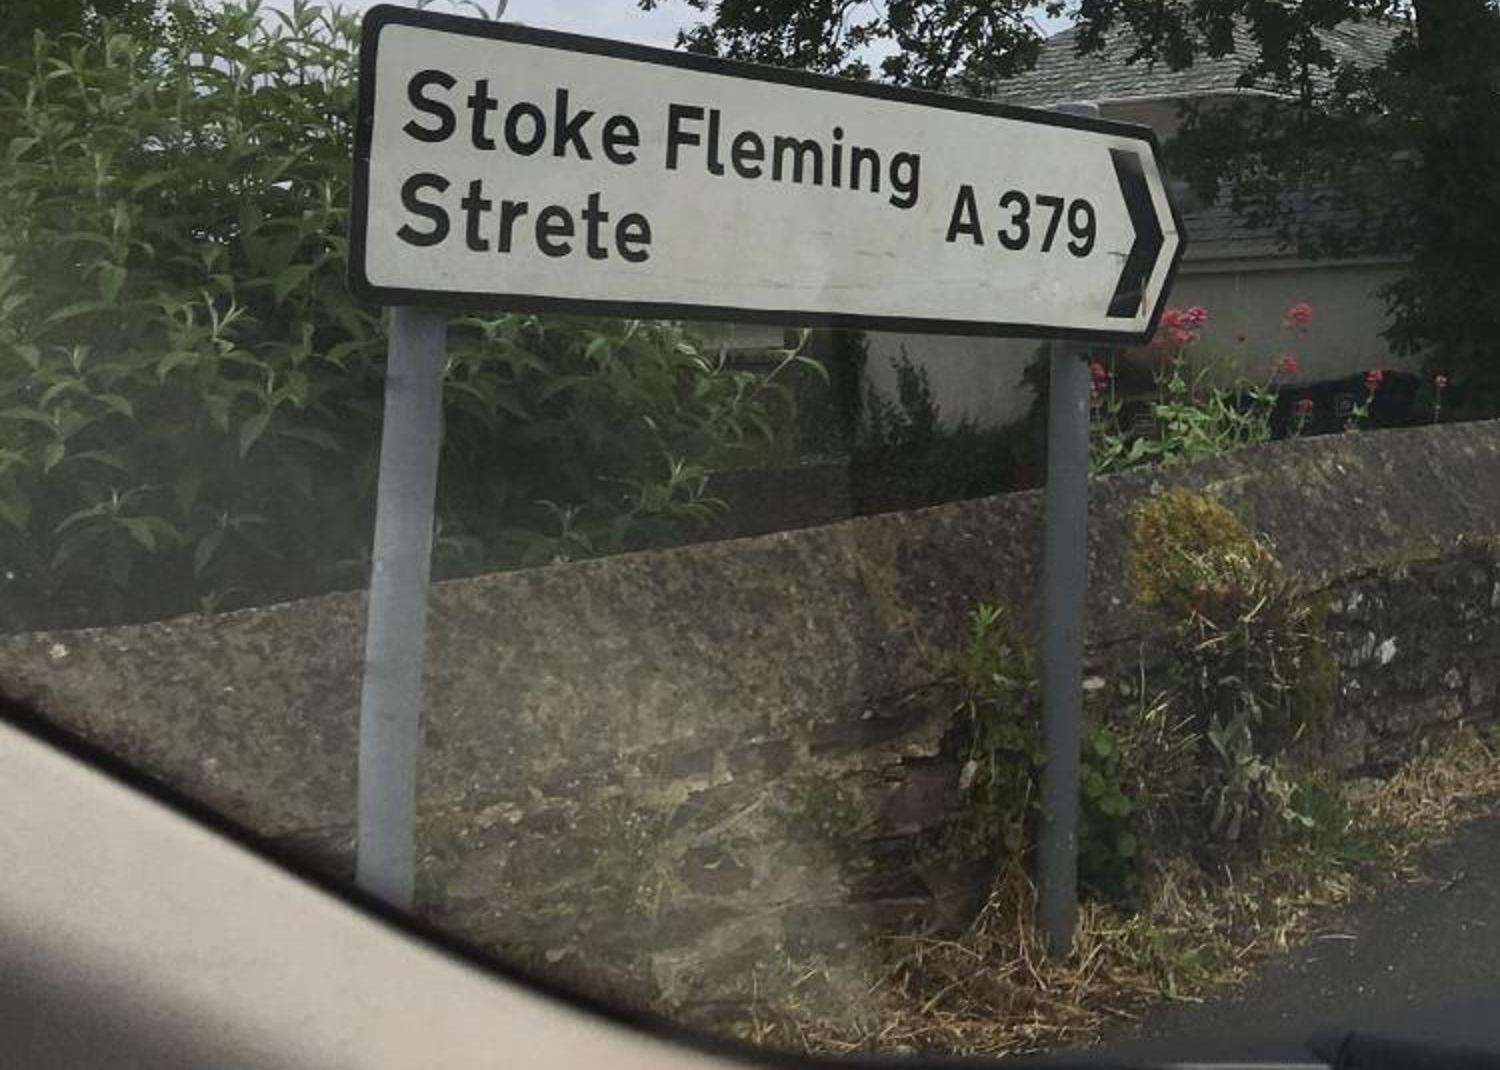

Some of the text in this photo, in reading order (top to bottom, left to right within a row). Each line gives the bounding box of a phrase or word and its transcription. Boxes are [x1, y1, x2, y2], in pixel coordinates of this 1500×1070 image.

[401, 68, 921, 211] Stoke Fleming
[395, 171, 653, 264] Strete
